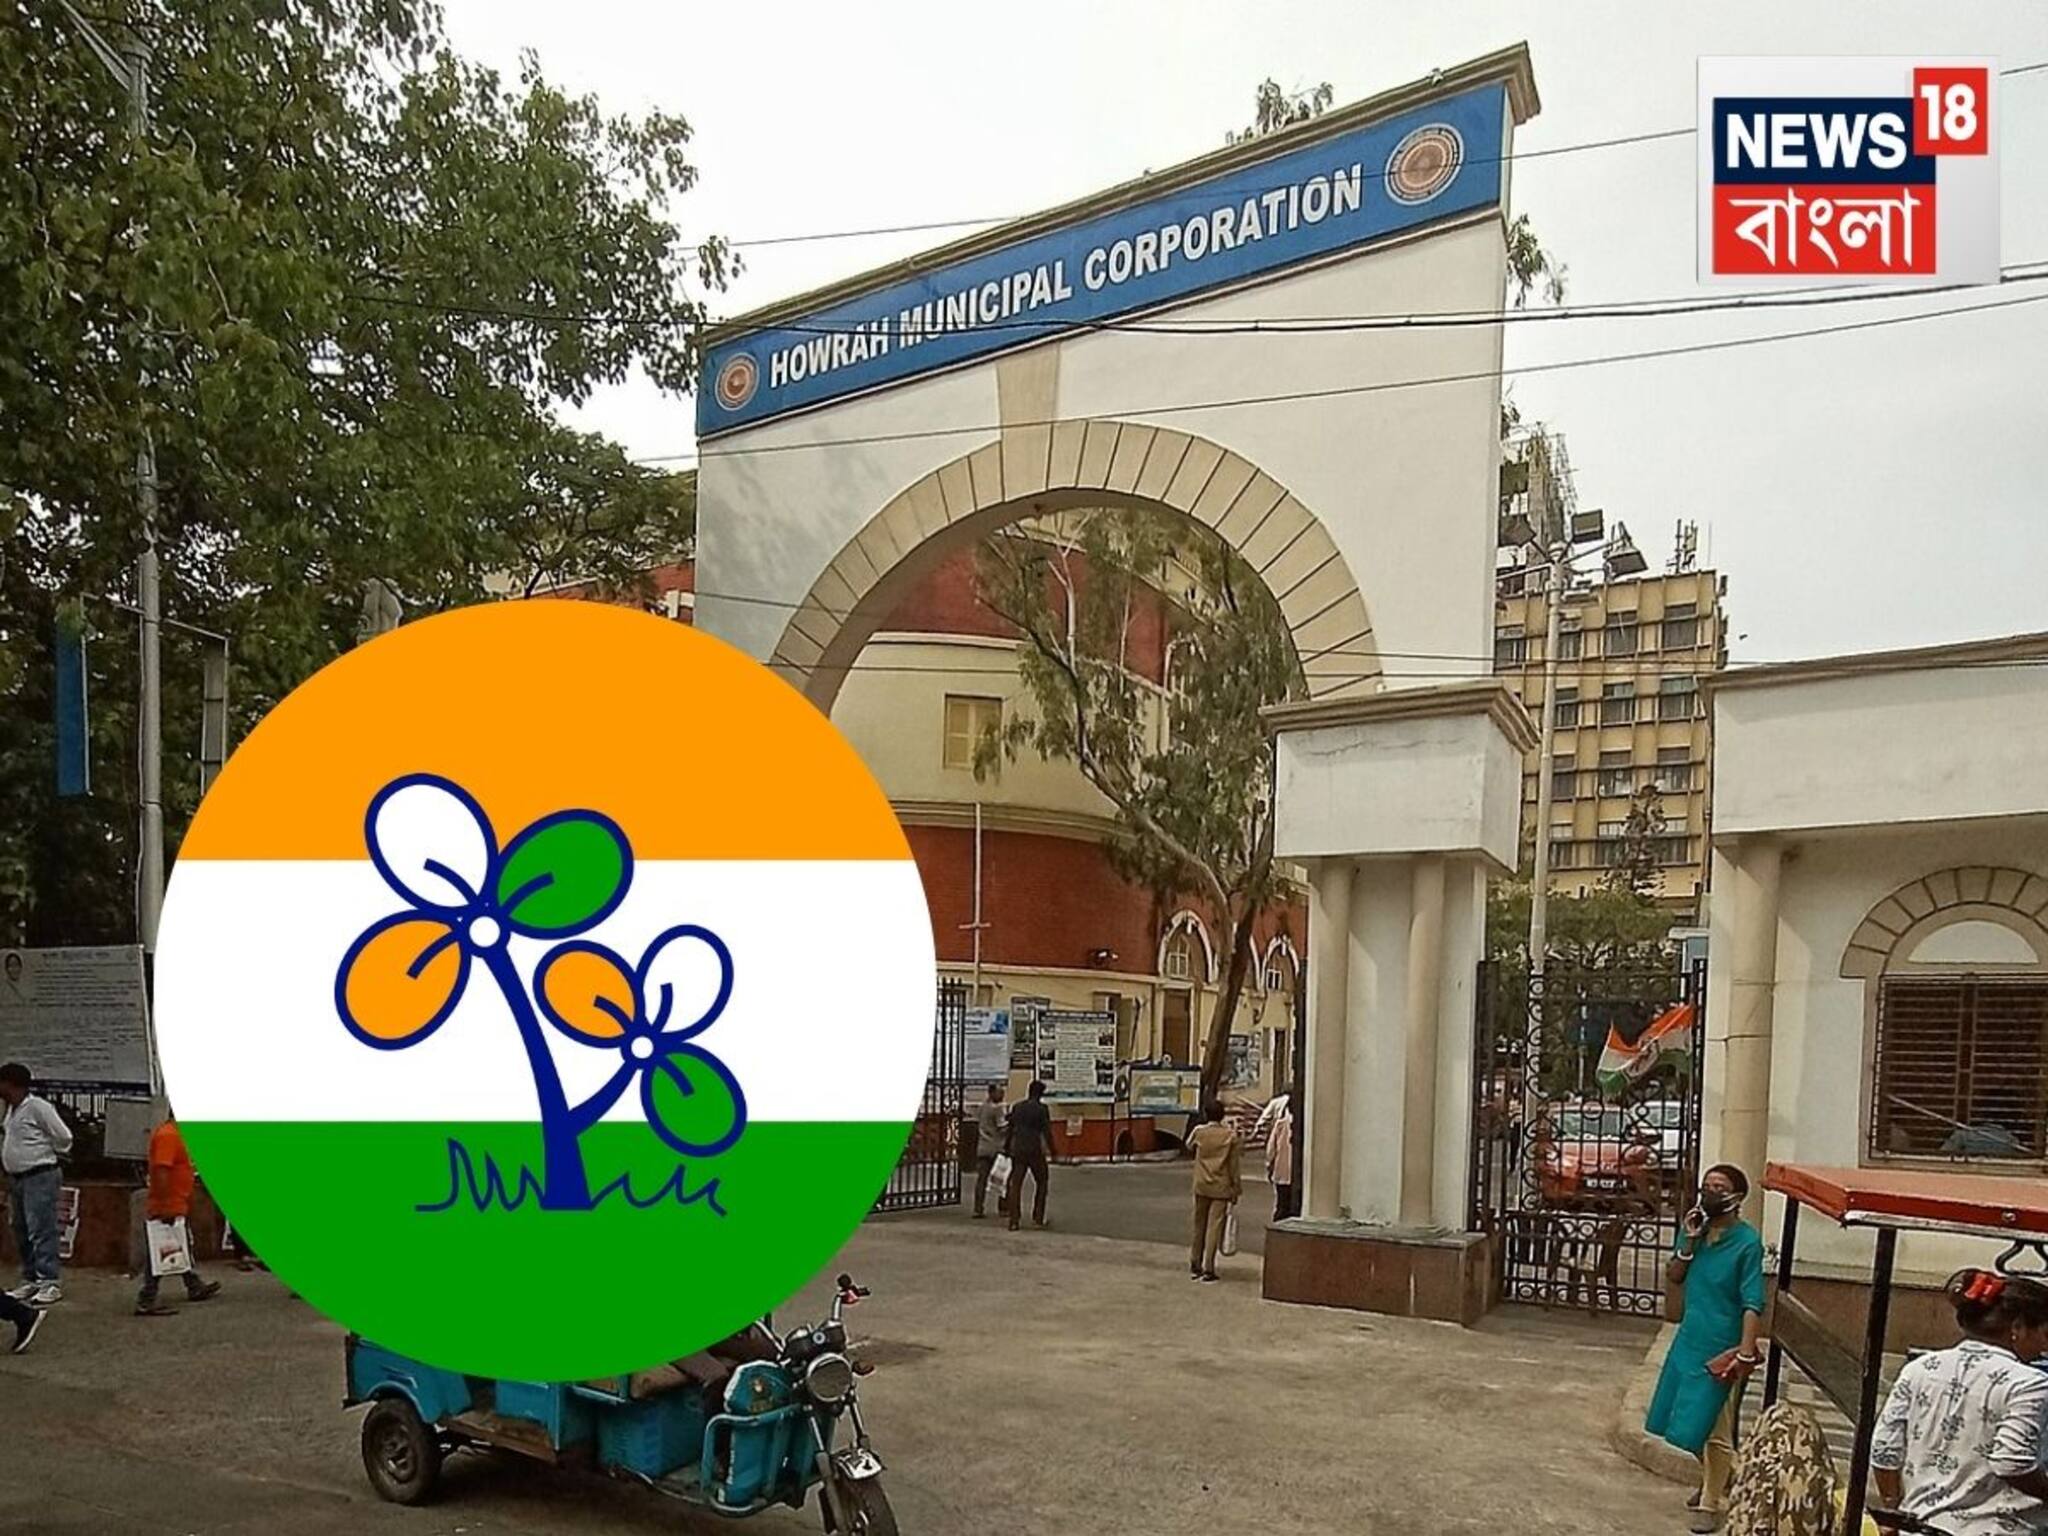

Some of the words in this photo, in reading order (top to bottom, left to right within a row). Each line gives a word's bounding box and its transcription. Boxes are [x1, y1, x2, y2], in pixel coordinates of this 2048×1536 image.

[770, 313, 890, 389] HOWRAH
[899, 259, 1073, 353] MUNICIPAL
[1083, 161, 1362, 292] CORPORATION
